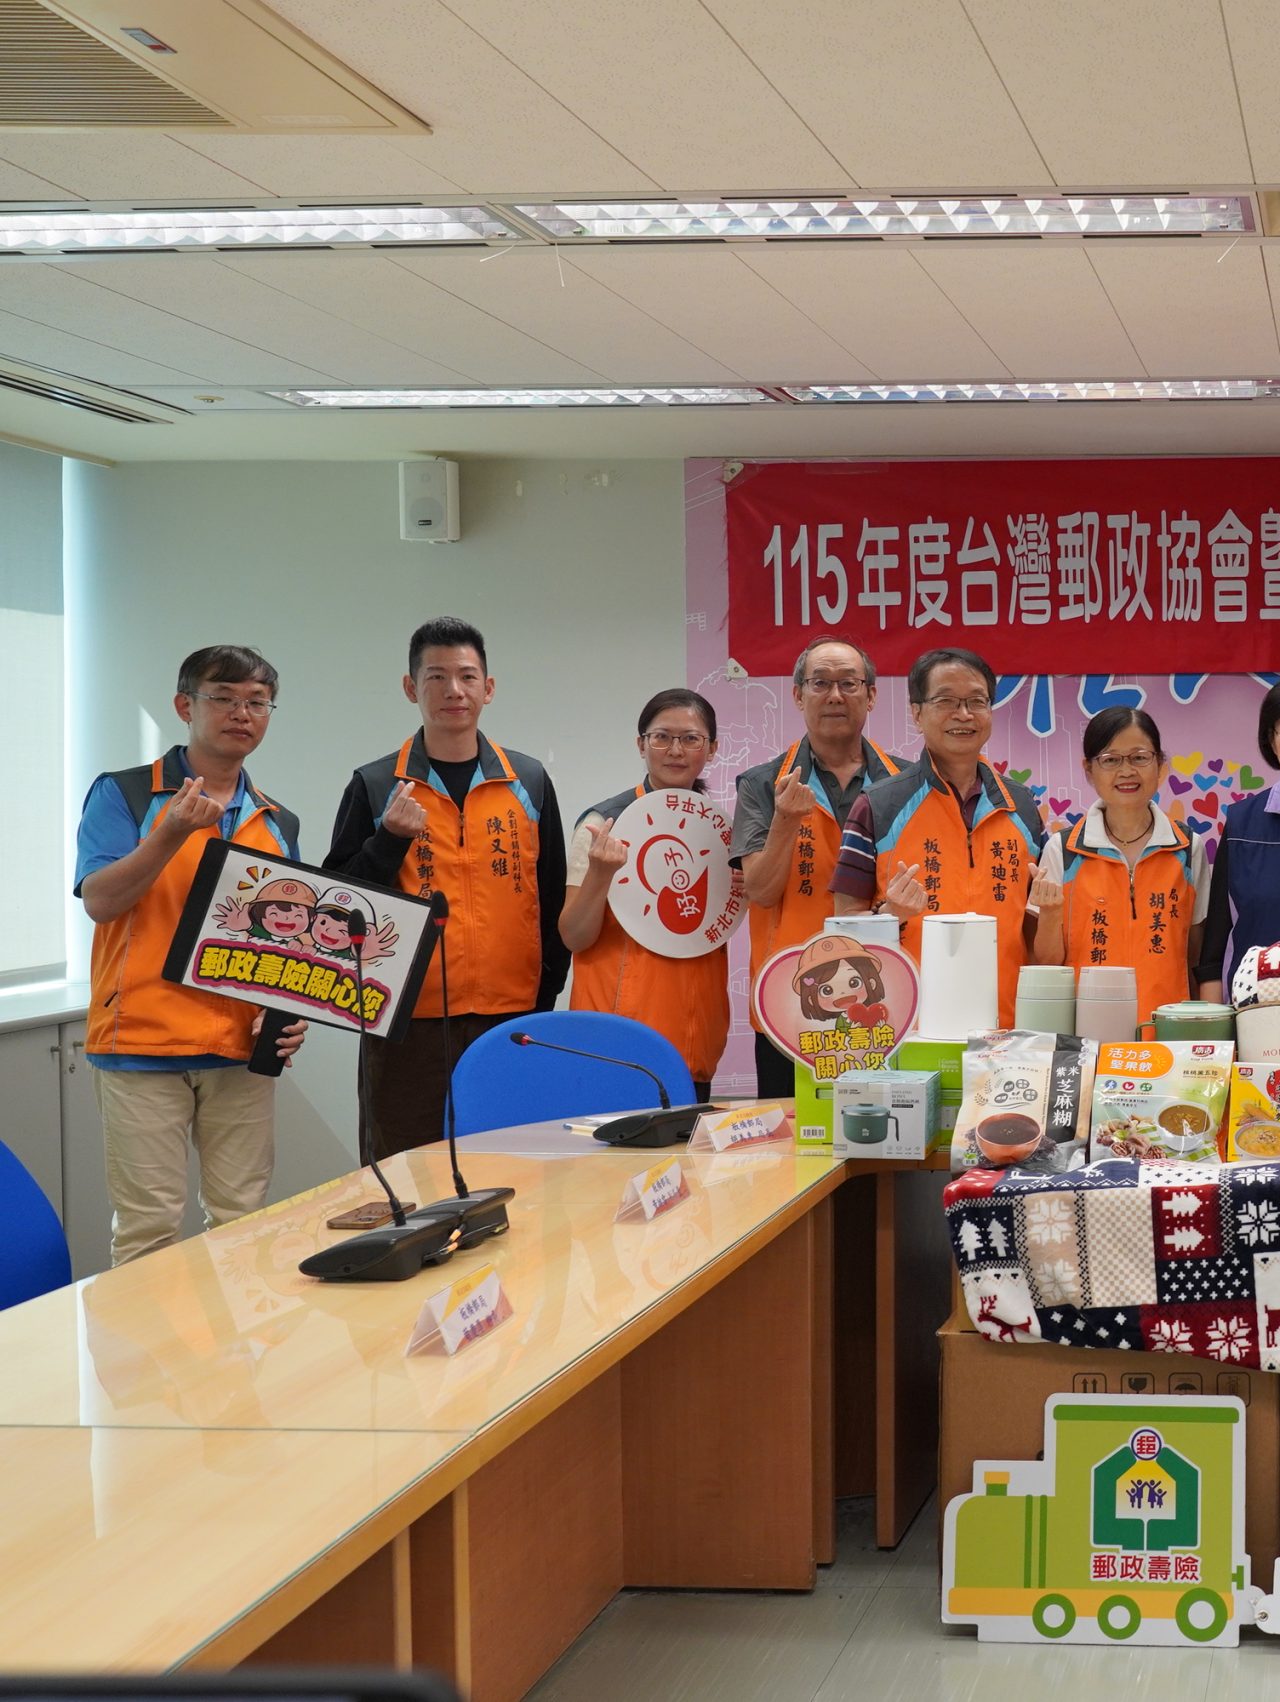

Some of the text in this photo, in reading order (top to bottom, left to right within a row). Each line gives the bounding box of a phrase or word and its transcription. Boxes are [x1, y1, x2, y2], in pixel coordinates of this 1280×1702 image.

[486, 816, 509, 877] 陳又維
[798, 824, 816, 897] 板橋郵局
[1007, 839, 1020, 883] 副局長
[923, 838, 942, 912] 板橋郵局
[1149, 892, 1166, 954] 胡美惠
[1168, 888, 1180, 918] 局長
[199, 947, 386, 1022] 郵政壽險關心您
[799, 1024, 896, 1055] 郵政壽險
[1107, 1047, 1152, 1060] 活力多
[1055, 1065, 1080, 1077] 紫米
[1052, 1079, 1075, 1127] 芝麻糊
[1136, 1435, 1157, 1455] 郵
[1092, 1554, 1201, 1582] 郵政壽險
